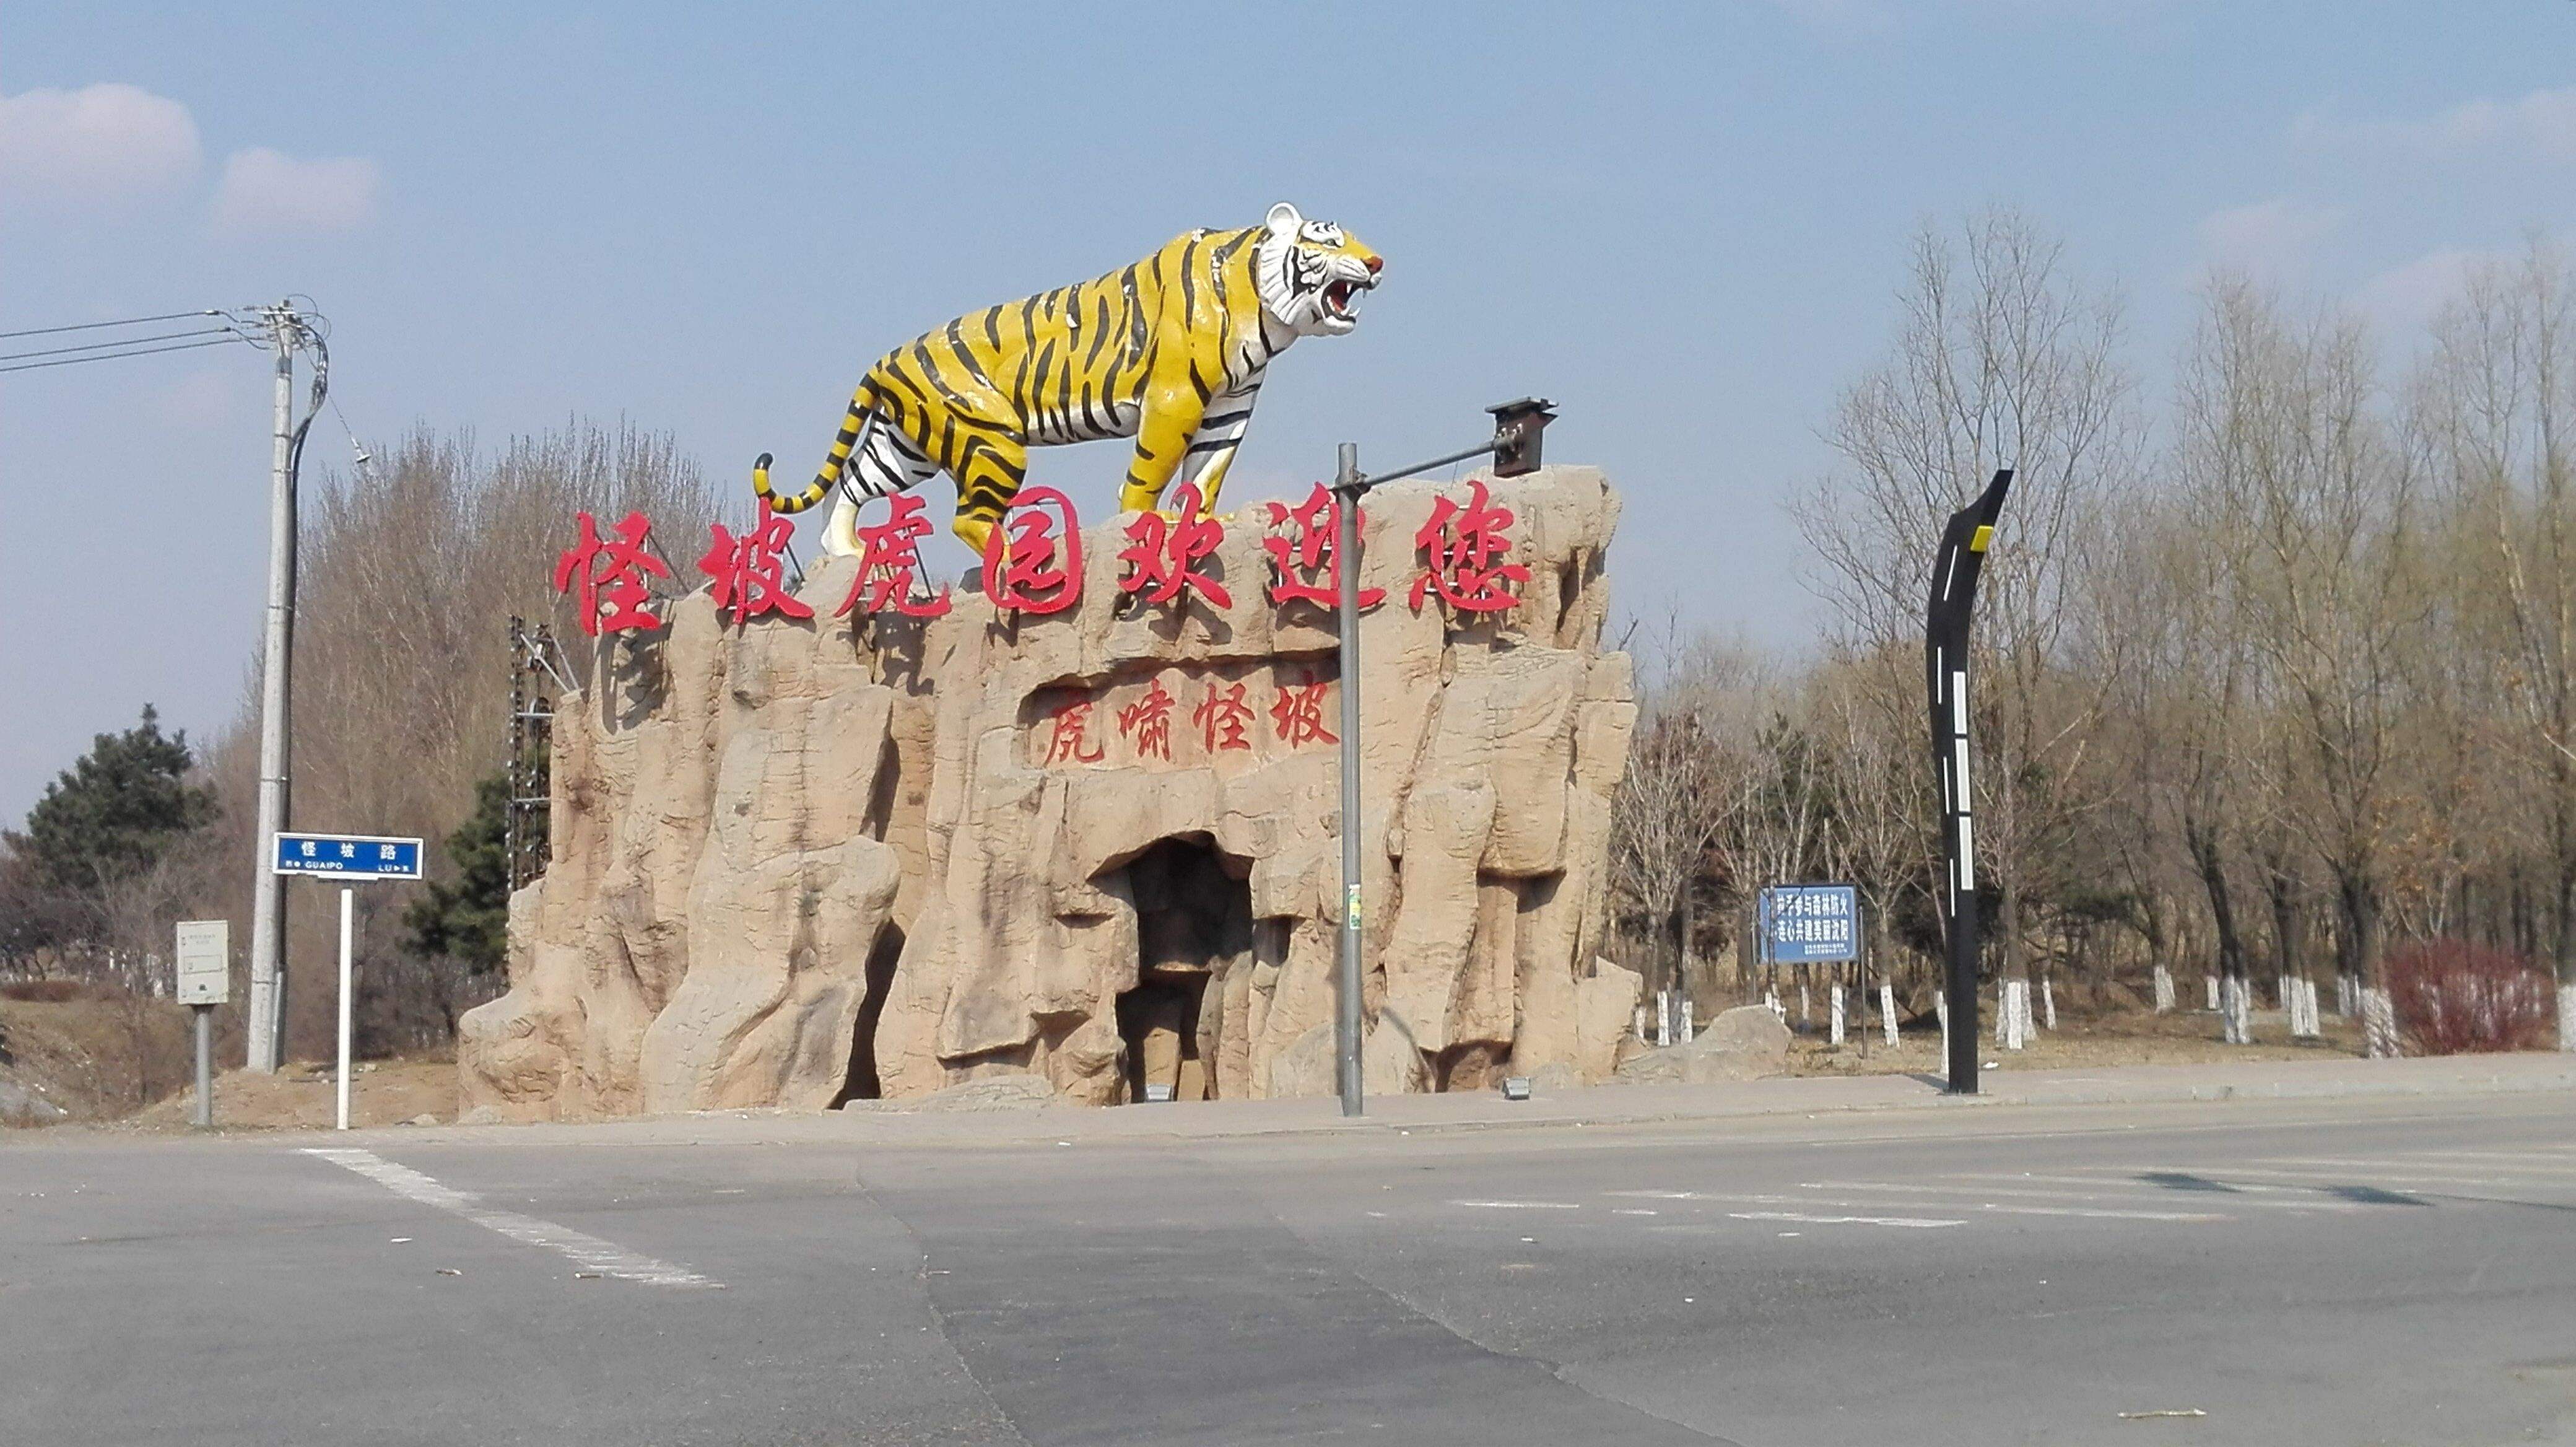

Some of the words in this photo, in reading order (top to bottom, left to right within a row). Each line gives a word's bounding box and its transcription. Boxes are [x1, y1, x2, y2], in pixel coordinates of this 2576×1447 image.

[554, 481, 1531, 636] 怪坡虎园欢迎您
[1043, 670, 1340, 768] 虎啸怪坡
[301, 841, 396, 860] 怪坡路
[305, 861, 344, 870] GUAIPO
[378, 864, 393, 872] LU
